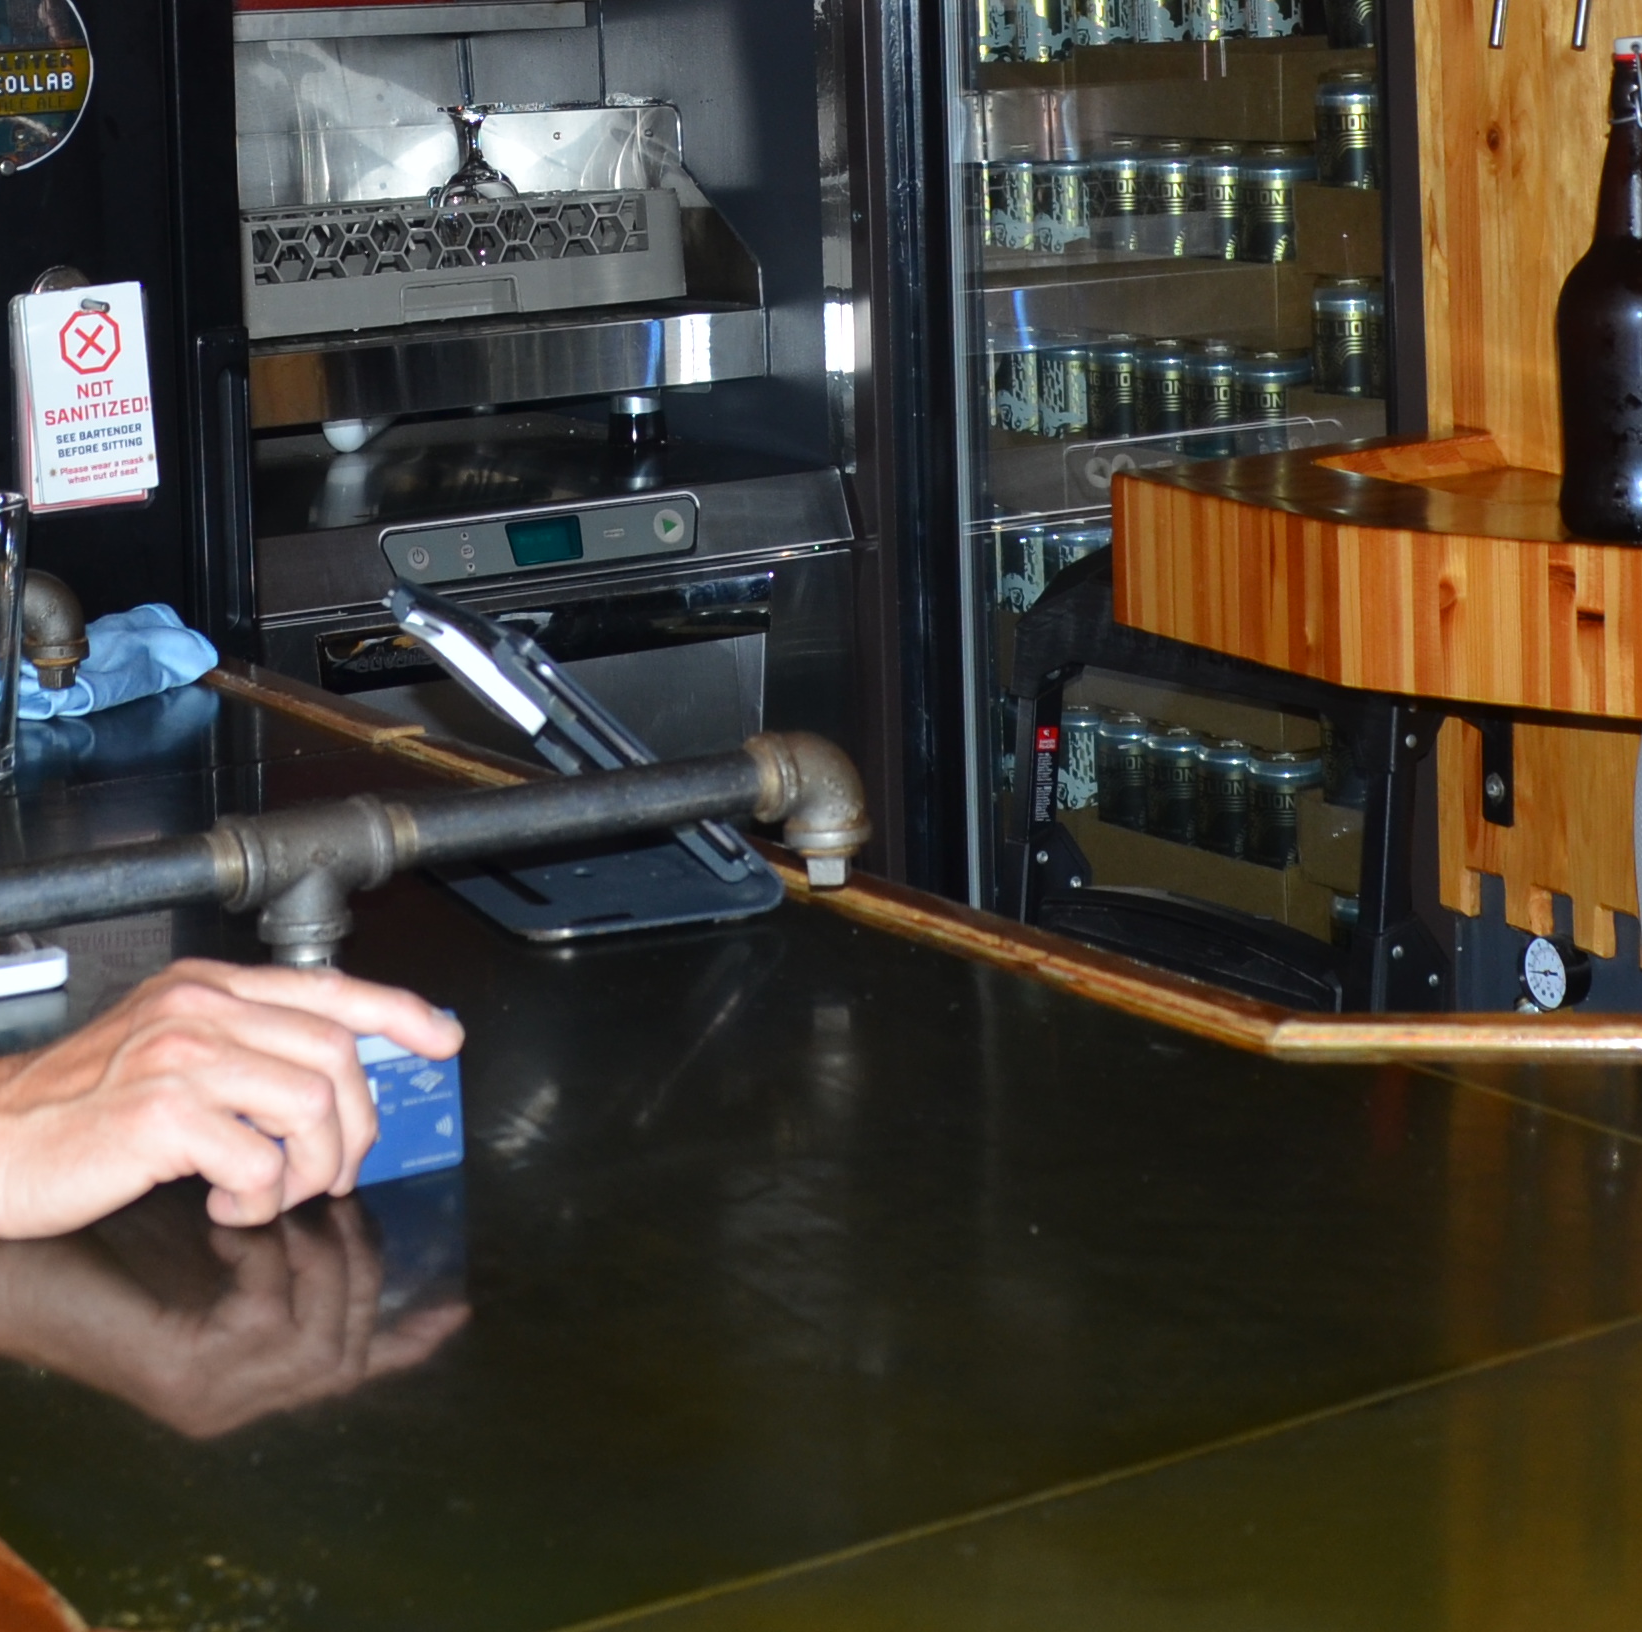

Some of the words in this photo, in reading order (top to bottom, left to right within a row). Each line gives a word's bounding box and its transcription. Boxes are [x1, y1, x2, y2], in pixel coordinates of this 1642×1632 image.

[77, 380, 113, 399] NOT
[45, 396, 149, 426] SANITIZED!
[56, 432, 76, 444] SEE
[79, 423, 142, 440] BARTENDER
[58, 444, 99, 458] BEFORE
[102, 437, 143, 451] SITTING
[60, 464, 89, 475] Please
[91, 462, 111, 471] wear
[122, 456, 144, 466] mask
[68, 475, 91, 484] when
[93, 472, 107, 480] out
[109, 469, 117, 478] of
[121, 468, 138, 476] seat
